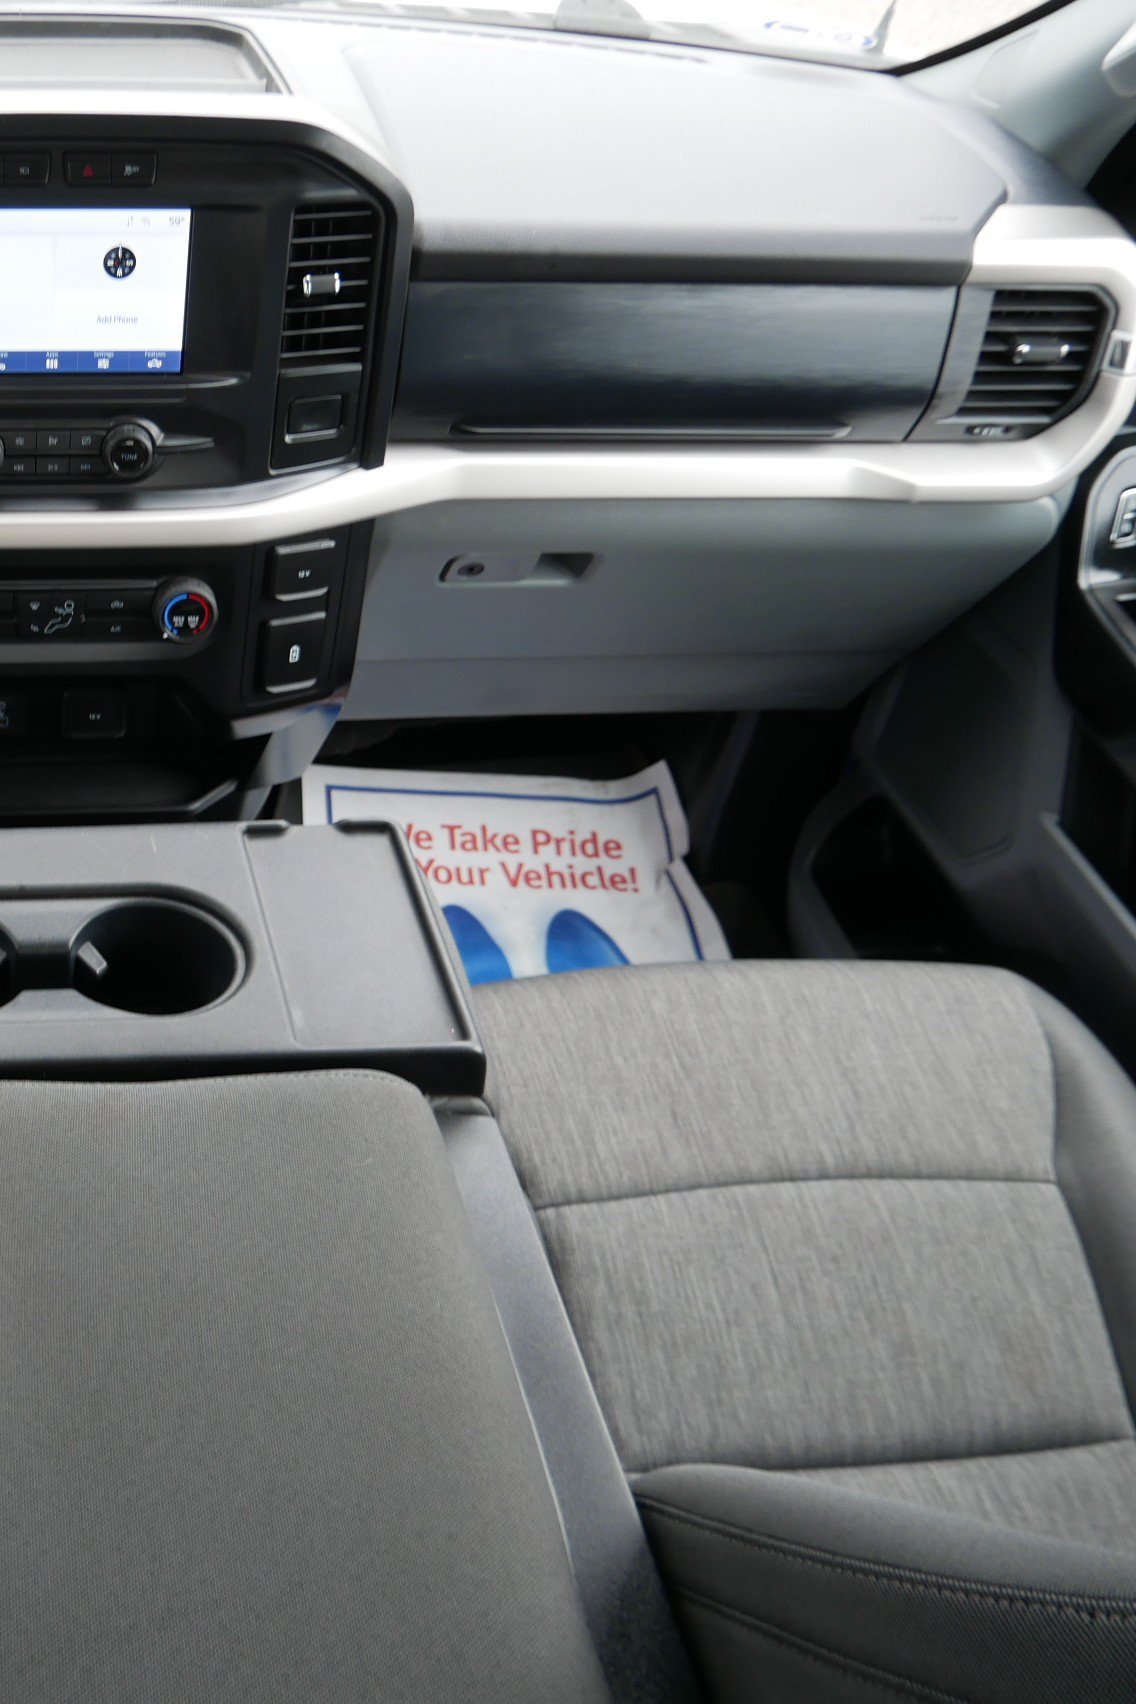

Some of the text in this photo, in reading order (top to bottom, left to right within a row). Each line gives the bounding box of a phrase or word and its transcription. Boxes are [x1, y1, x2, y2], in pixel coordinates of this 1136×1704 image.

[96, 314, 138, 325] Add Phone
[441, 824, 519, 854] Take
[530, 829, 623, 860] Pride
[416, 858, 640, 893] Your Vehicle!
